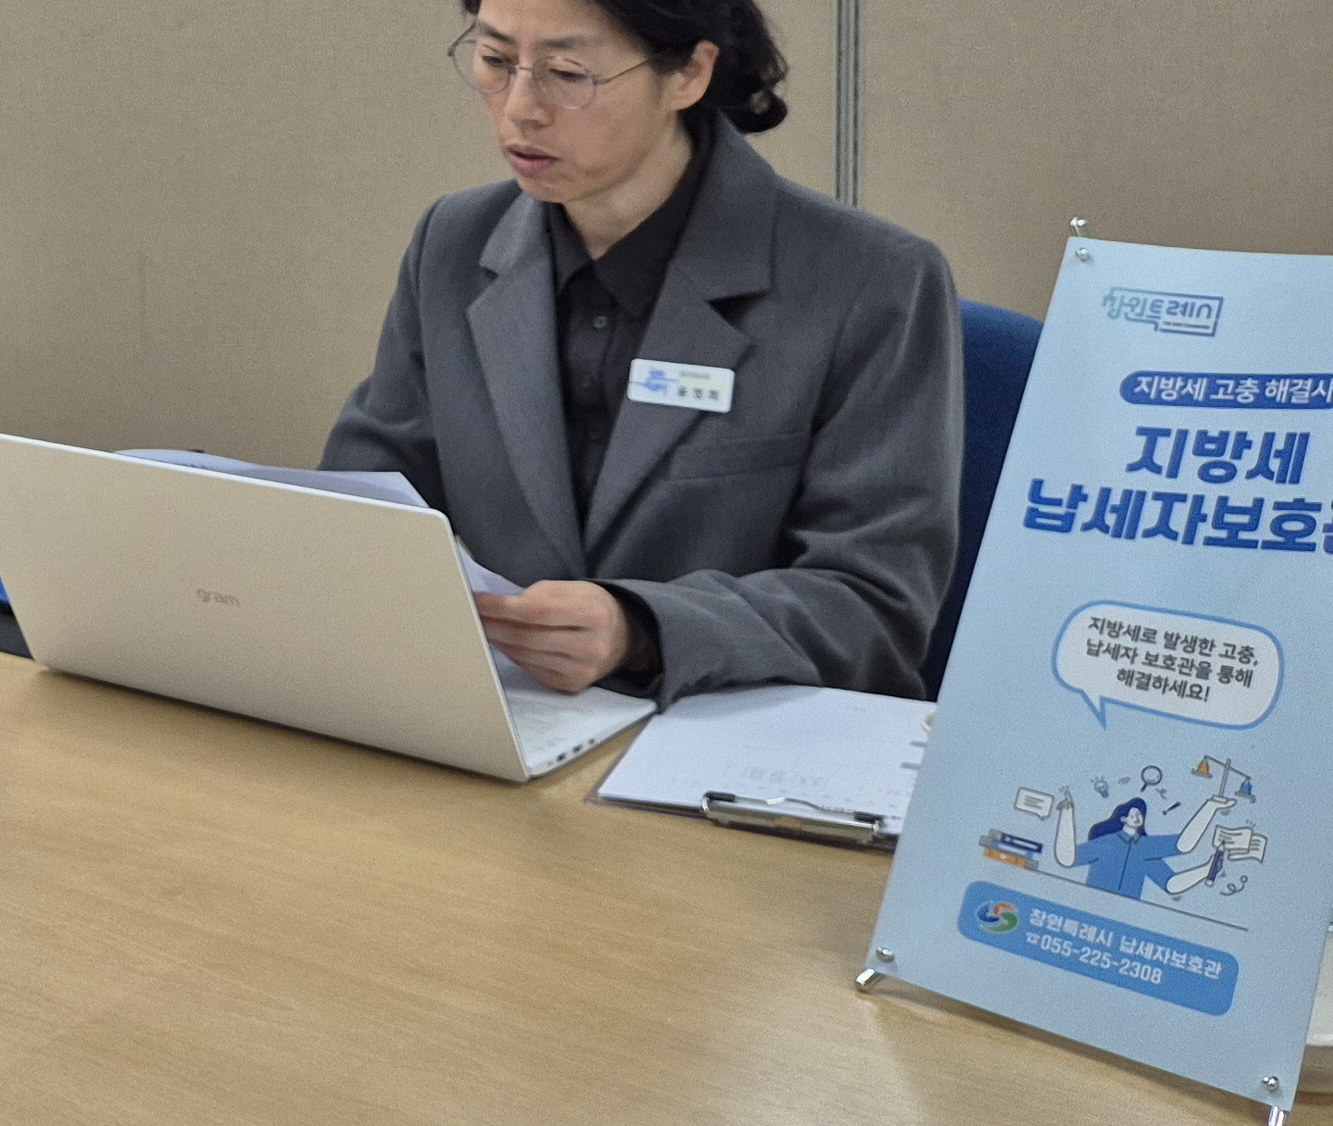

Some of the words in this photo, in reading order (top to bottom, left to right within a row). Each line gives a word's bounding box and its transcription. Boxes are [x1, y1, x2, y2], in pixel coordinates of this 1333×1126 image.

[1133, 375, 1208, 402] 지방세
[1209, 377, 1260, 404] 고충
[1264, 377, 1333, 404] 해결사
[1125, 426, 1311, 486] 지방세
[1022, 478, 1333, 556] 납세자보호
[1085, 638, 1139, 665] 납세자
[1141, 650, 1213, 681] 보호관을
[1216, 664, 1254, 689] 통해
[1087, 616, 1158, 645] 지방세로
[1163, 630, 1216, 658] 발생한
[1218, 642, 1259, 667] 고충,
[1116, 668, 1211, 703] 해결하세요!
[1028, 908, 1114, 948] 창원특례시
[1118, 935, 1223, 980] 납세자보호관
[1039, 934, 1164, 985] 055-225-2308
